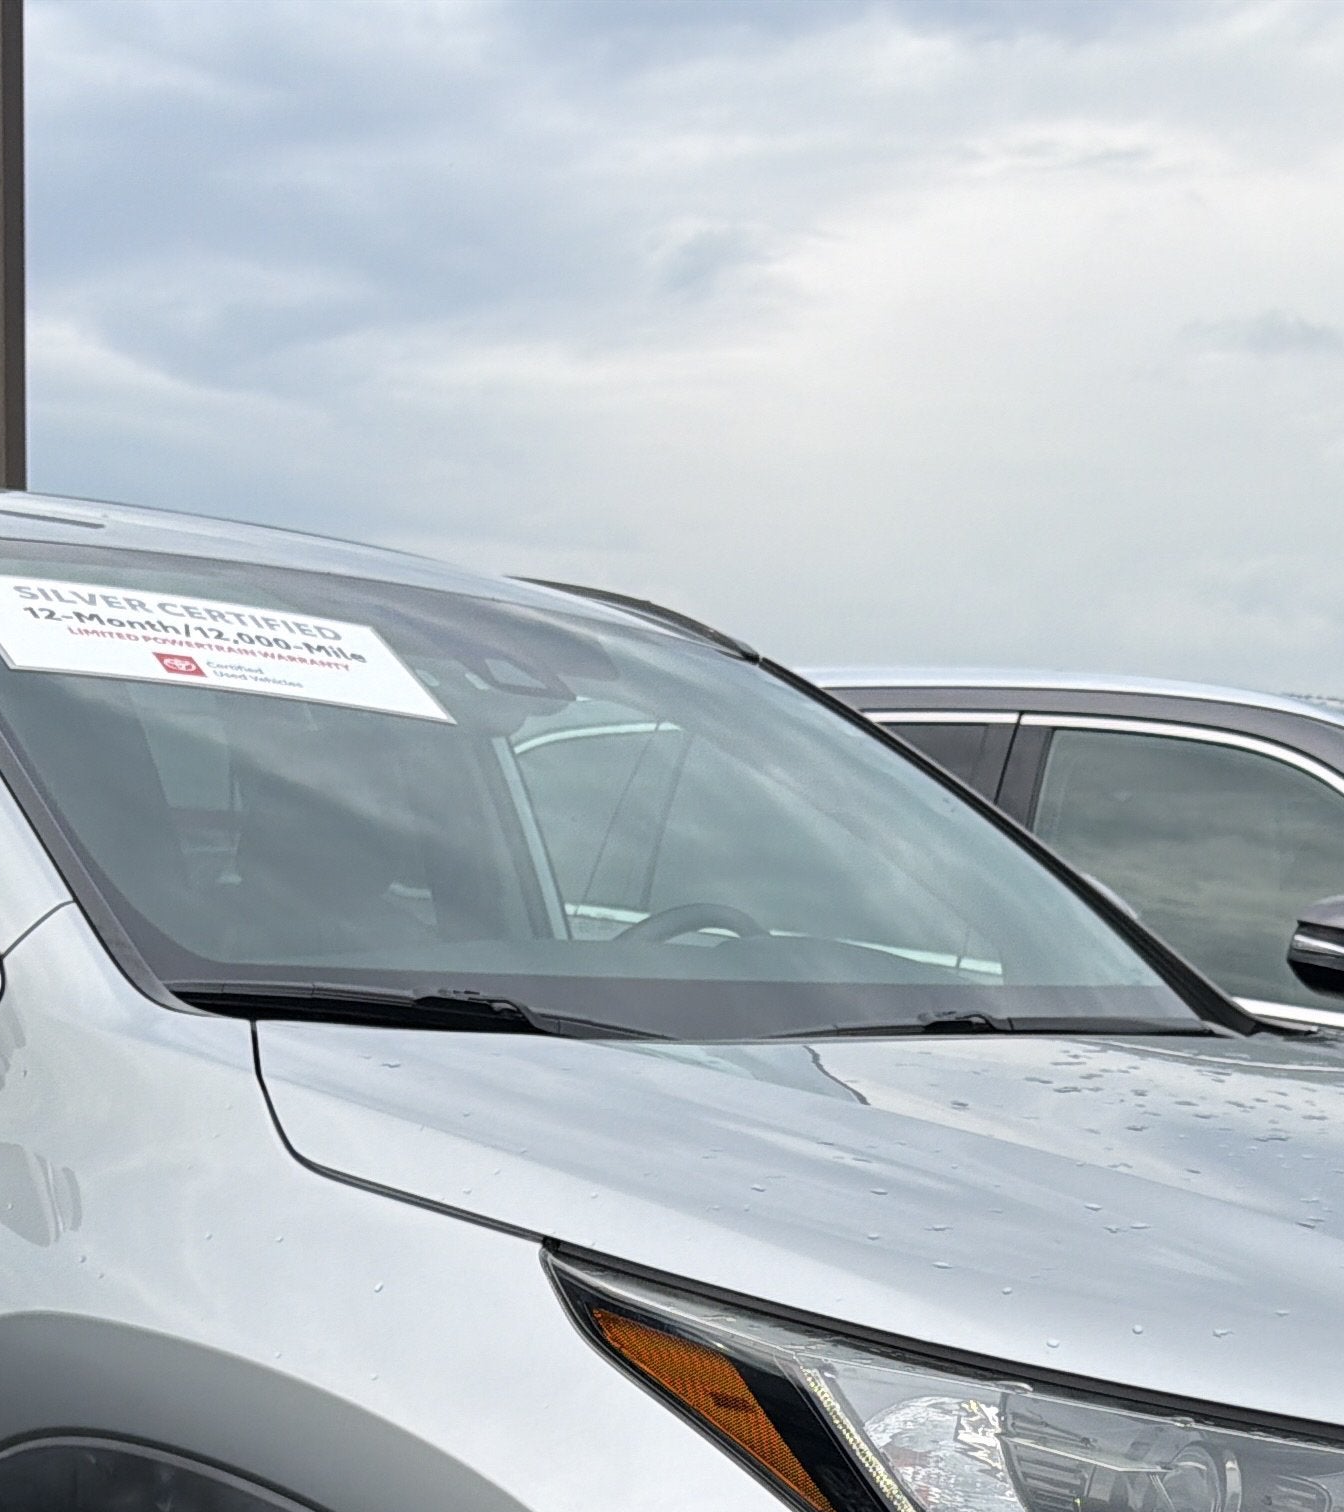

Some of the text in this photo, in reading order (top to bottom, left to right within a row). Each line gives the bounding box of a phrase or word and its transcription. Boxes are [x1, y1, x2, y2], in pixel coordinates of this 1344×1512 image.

[12, 585, 342, 641] SILVER CERTIFIED
[23, 606, 368, 663] 12-Month/12,000-Mile
[67, 626, 350, 672] LIMITED POWERTRAIN WARRANTY
[206, 660, 264, 674] Certified
